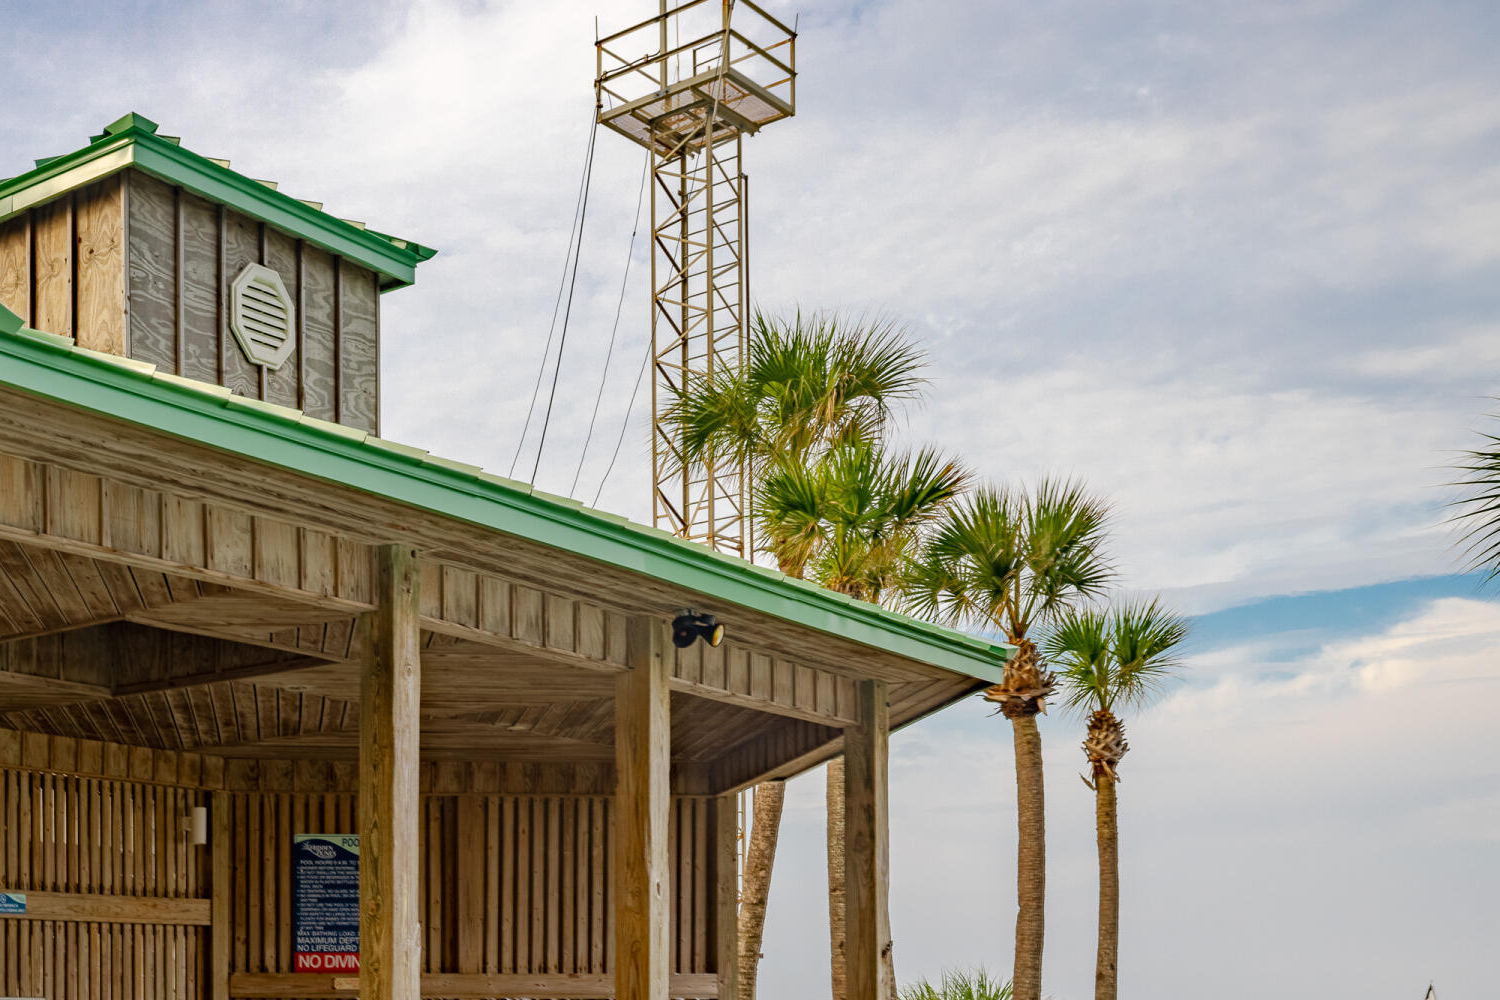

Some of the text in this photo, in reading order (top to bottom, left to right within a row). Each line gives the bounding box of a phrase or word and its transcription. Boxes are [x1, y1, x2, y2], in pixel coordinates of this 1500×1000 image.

[342, 838, 359, 847] POO
[298, 955, 360, 969] NO DIVIN
